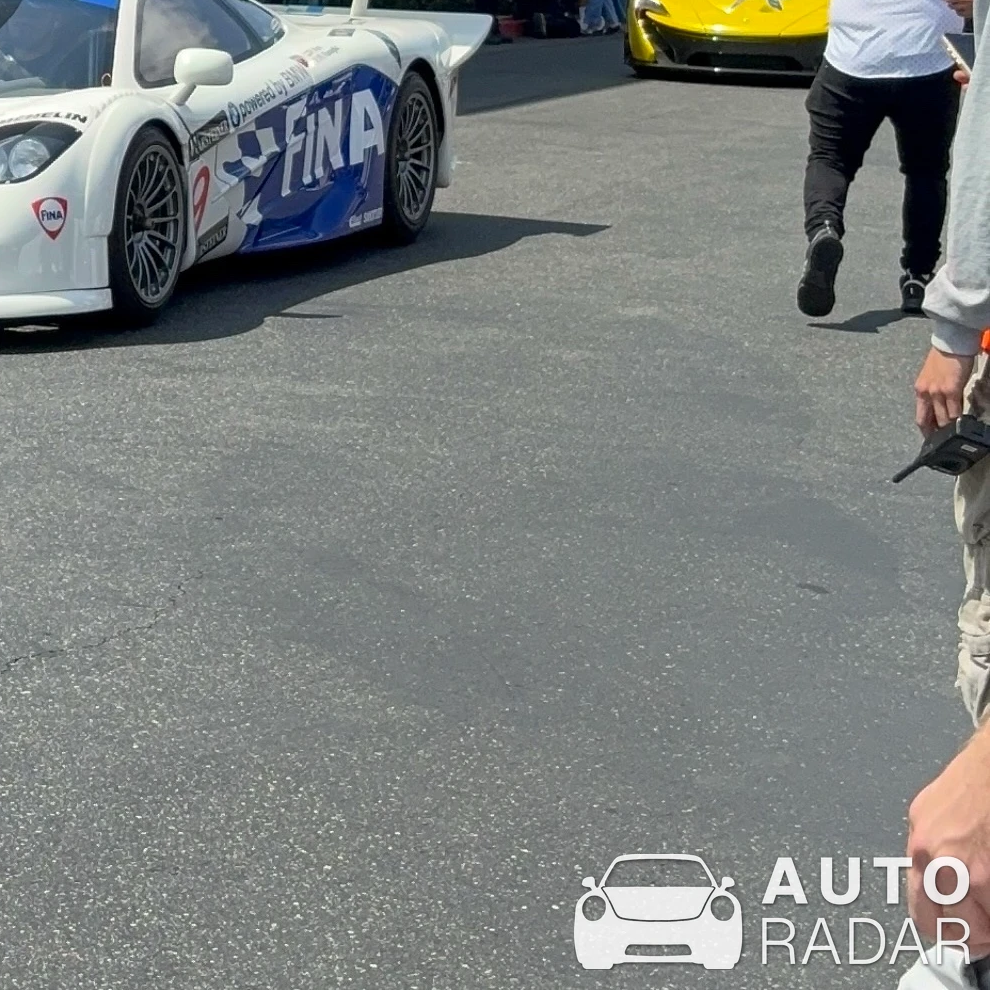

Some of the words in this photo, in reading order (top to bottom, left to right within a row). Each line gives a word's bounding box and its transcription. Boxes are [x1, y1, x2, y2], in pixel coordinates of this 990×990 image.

[280, 65, 310, 88] BMW
[278, 80, 288, 97] by
[239, 84, 276, 122] powered
[281, 88, 385, 197] FINA
[40, 209, 64, 221] FINA
